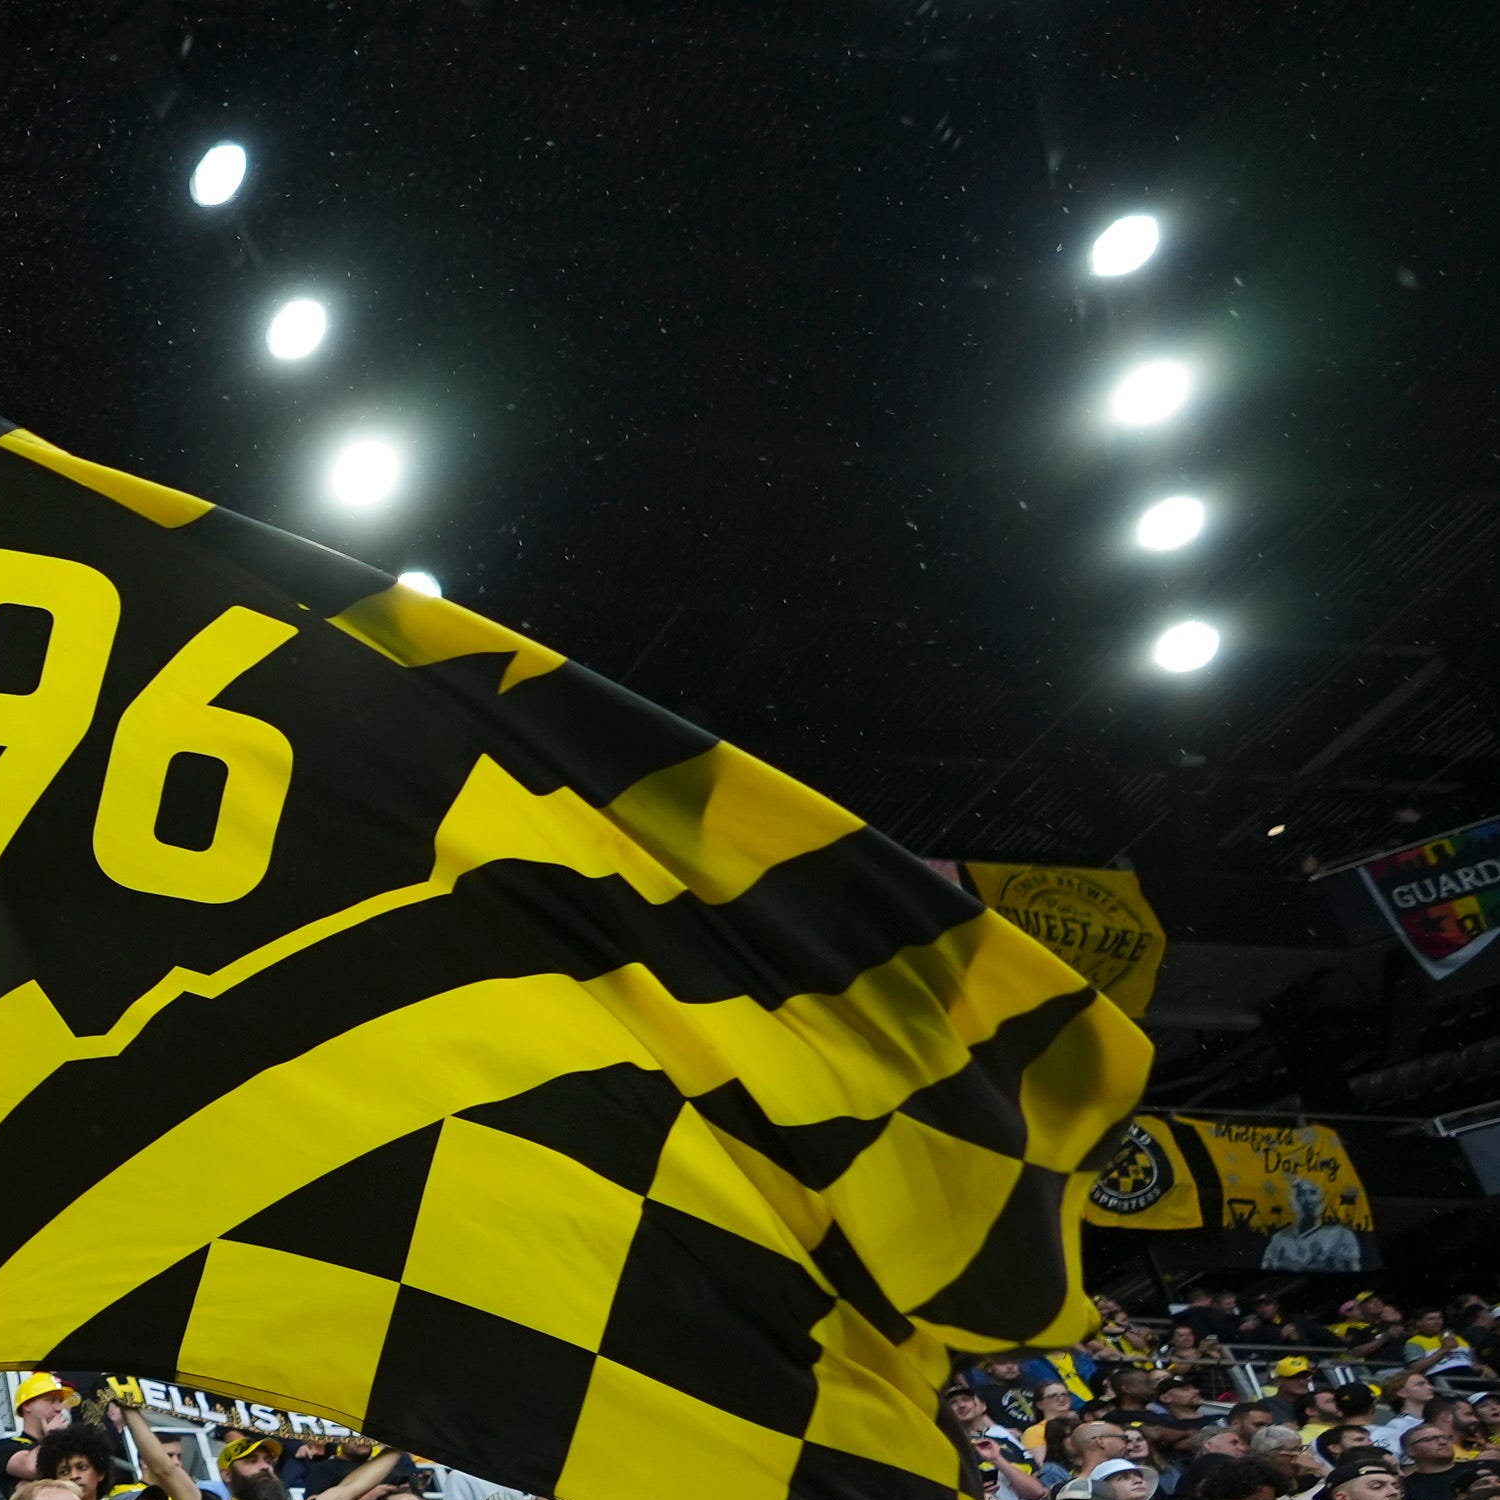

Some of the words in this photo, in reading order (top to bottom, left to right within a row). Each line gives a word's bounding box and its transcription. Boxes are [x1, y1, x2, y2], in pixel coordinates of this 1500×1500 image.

[1094, 925, 1154, 962] DEE
[1263, 1145, 1342, 1183] Darling
[1092, 1184, 1162, 1212] UPPORTERS
[105, 1375, 229, 1425] HELL
[233, 1399, 283, 1433] IS
[287, 1411, 362, 1438] RE
